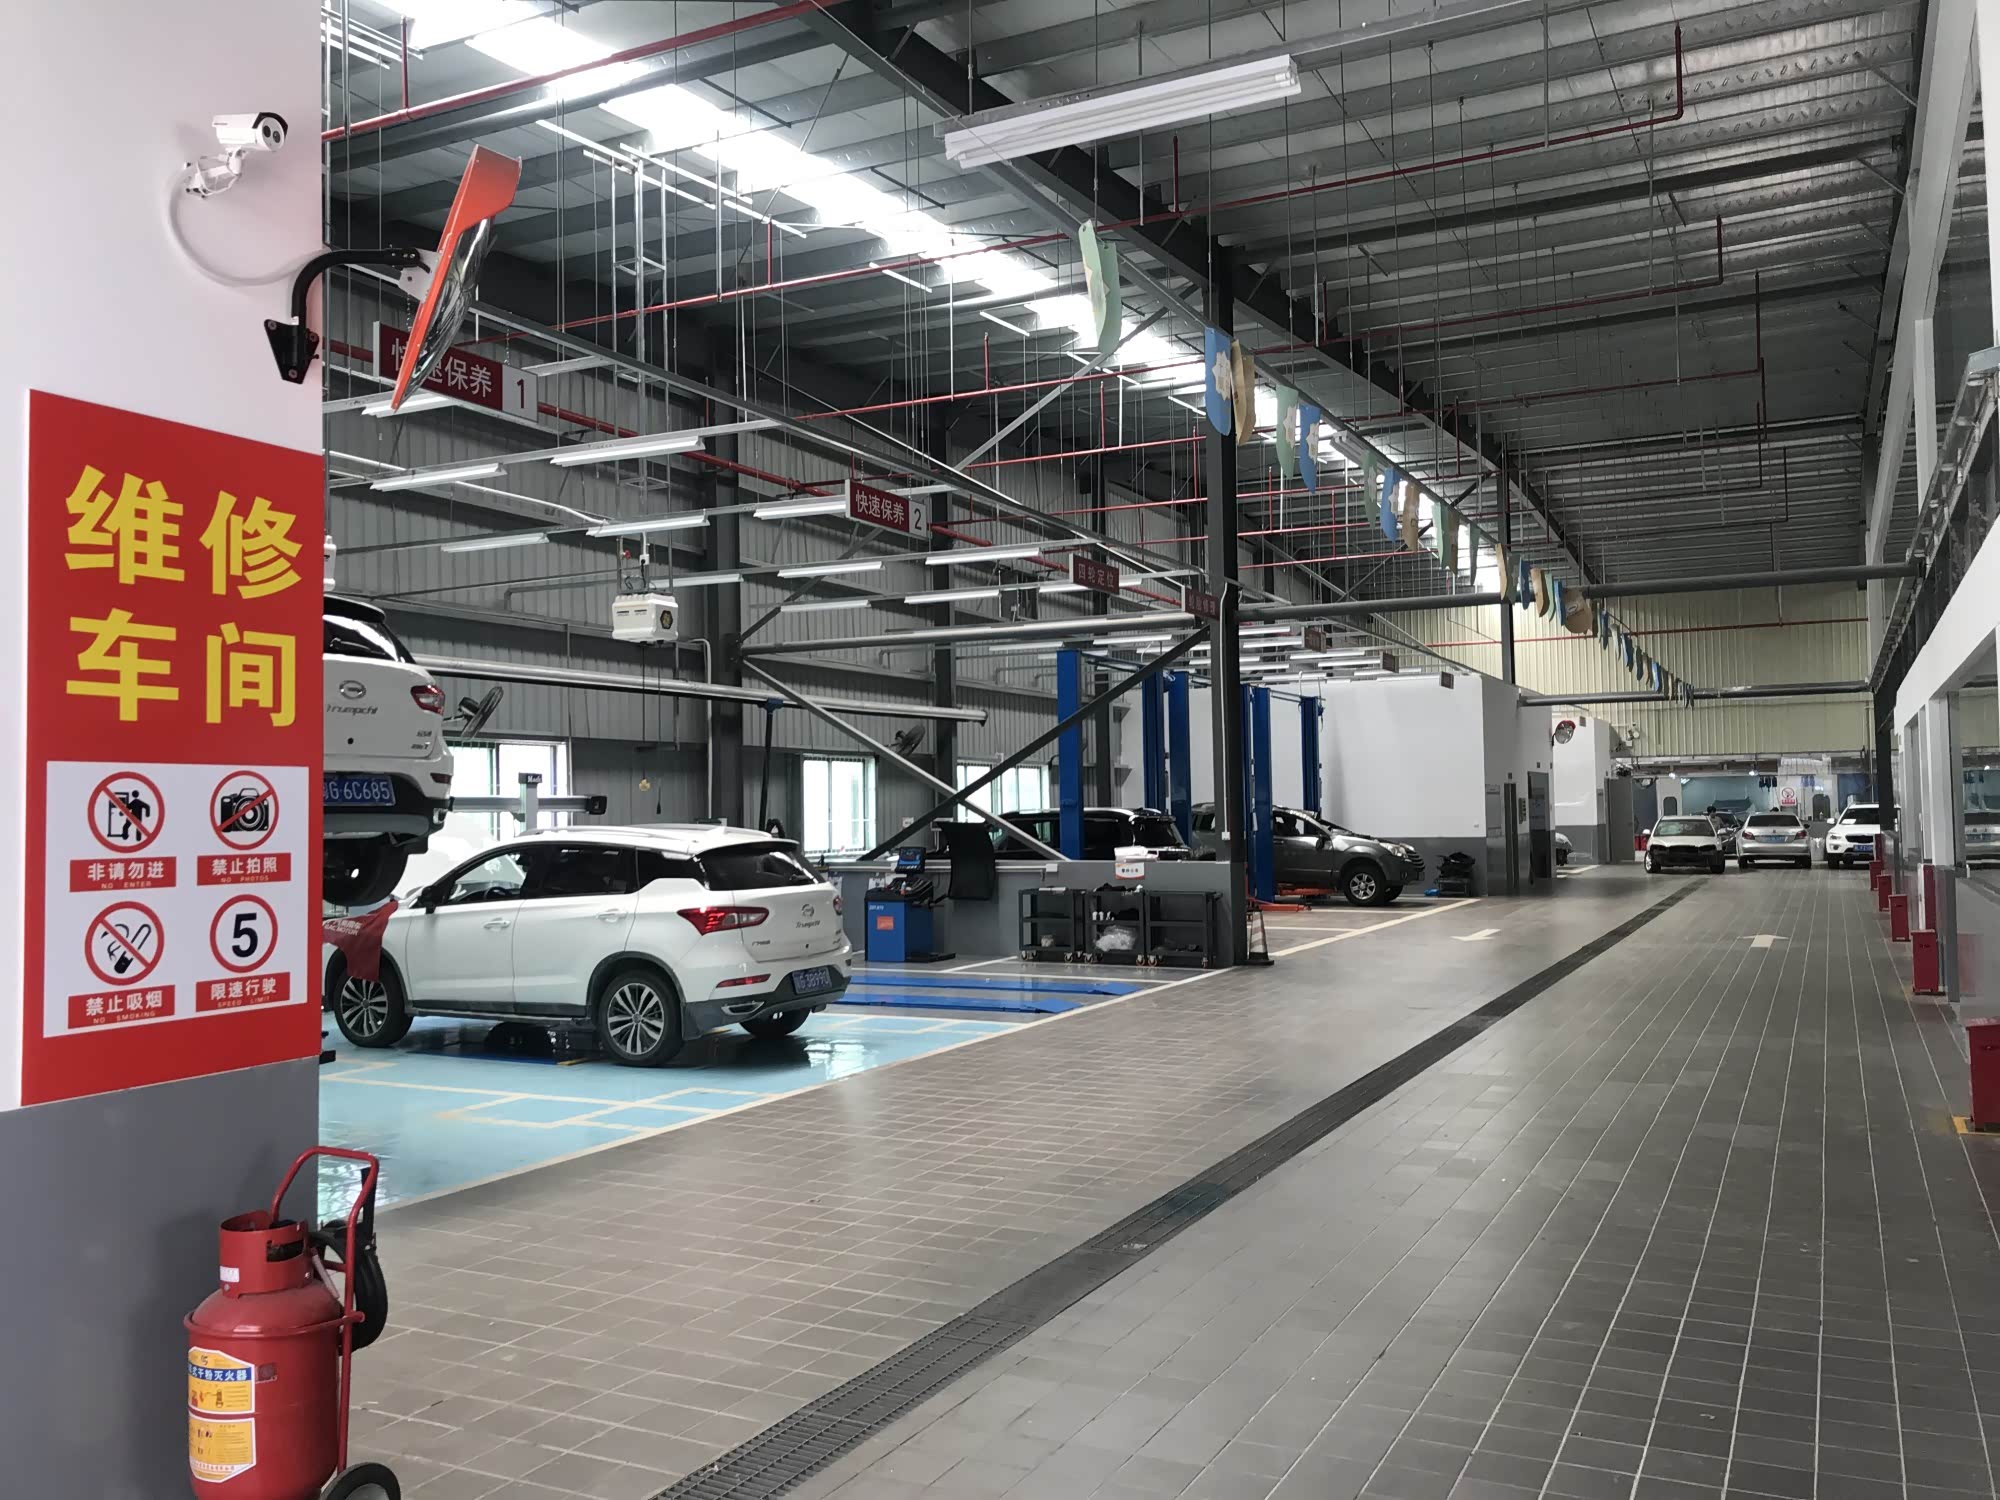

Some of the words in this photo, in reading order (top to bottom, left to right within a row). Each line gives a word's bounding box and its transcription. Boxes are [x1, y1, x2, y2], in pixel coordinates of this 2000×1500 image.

[516, 378, 525, 409] 1
[855, 489, 905, 525] 快速保养
[914, 508, 922, 531] 2
[64, 464, 303, 600] 维修
[1078, 563, 1115, 589] 四轮定位
[65, 607, 298, 728] 车间
[87, 861, 165, 881] 非请勿进
[211, 857, 278, 876] 禁止拍照
[123, 881, 152, 889] ENTER
[231, 912, 259, 958] 5
[210, 977, 277, 1001] 限速行驶
[217, 999, 242, 1008] SPEED
[250, 996, 270, 1004] LIMIT
[86, 990, 163, 1017] 禁止吸烟
[116, 1011, 156, 1022] SMOKING
